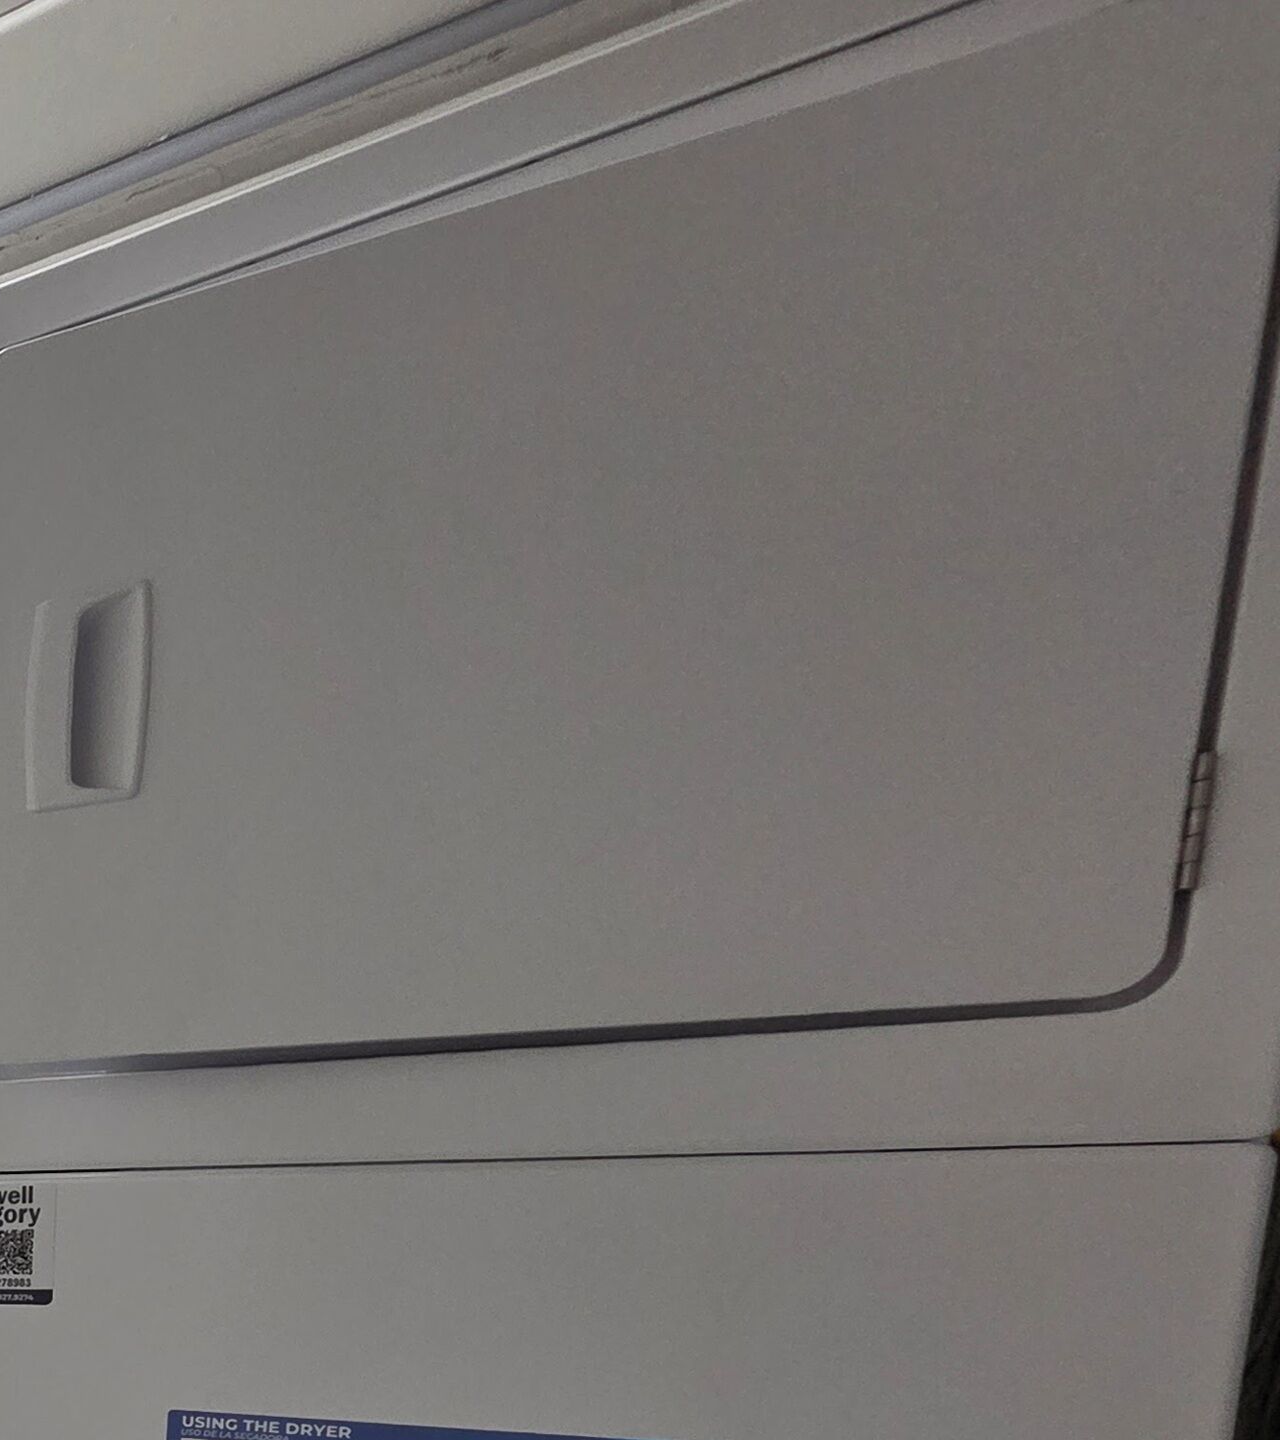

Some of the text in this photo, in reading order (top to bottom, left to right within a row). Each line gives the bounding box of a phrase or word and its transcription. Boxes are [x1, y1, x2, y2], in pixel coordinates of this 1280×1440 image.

[181, 1428, 202, 1436] USO
[218, 1431, 232, 1439] LA
[182, 1415, 352, 1439] USING THE DRYER
